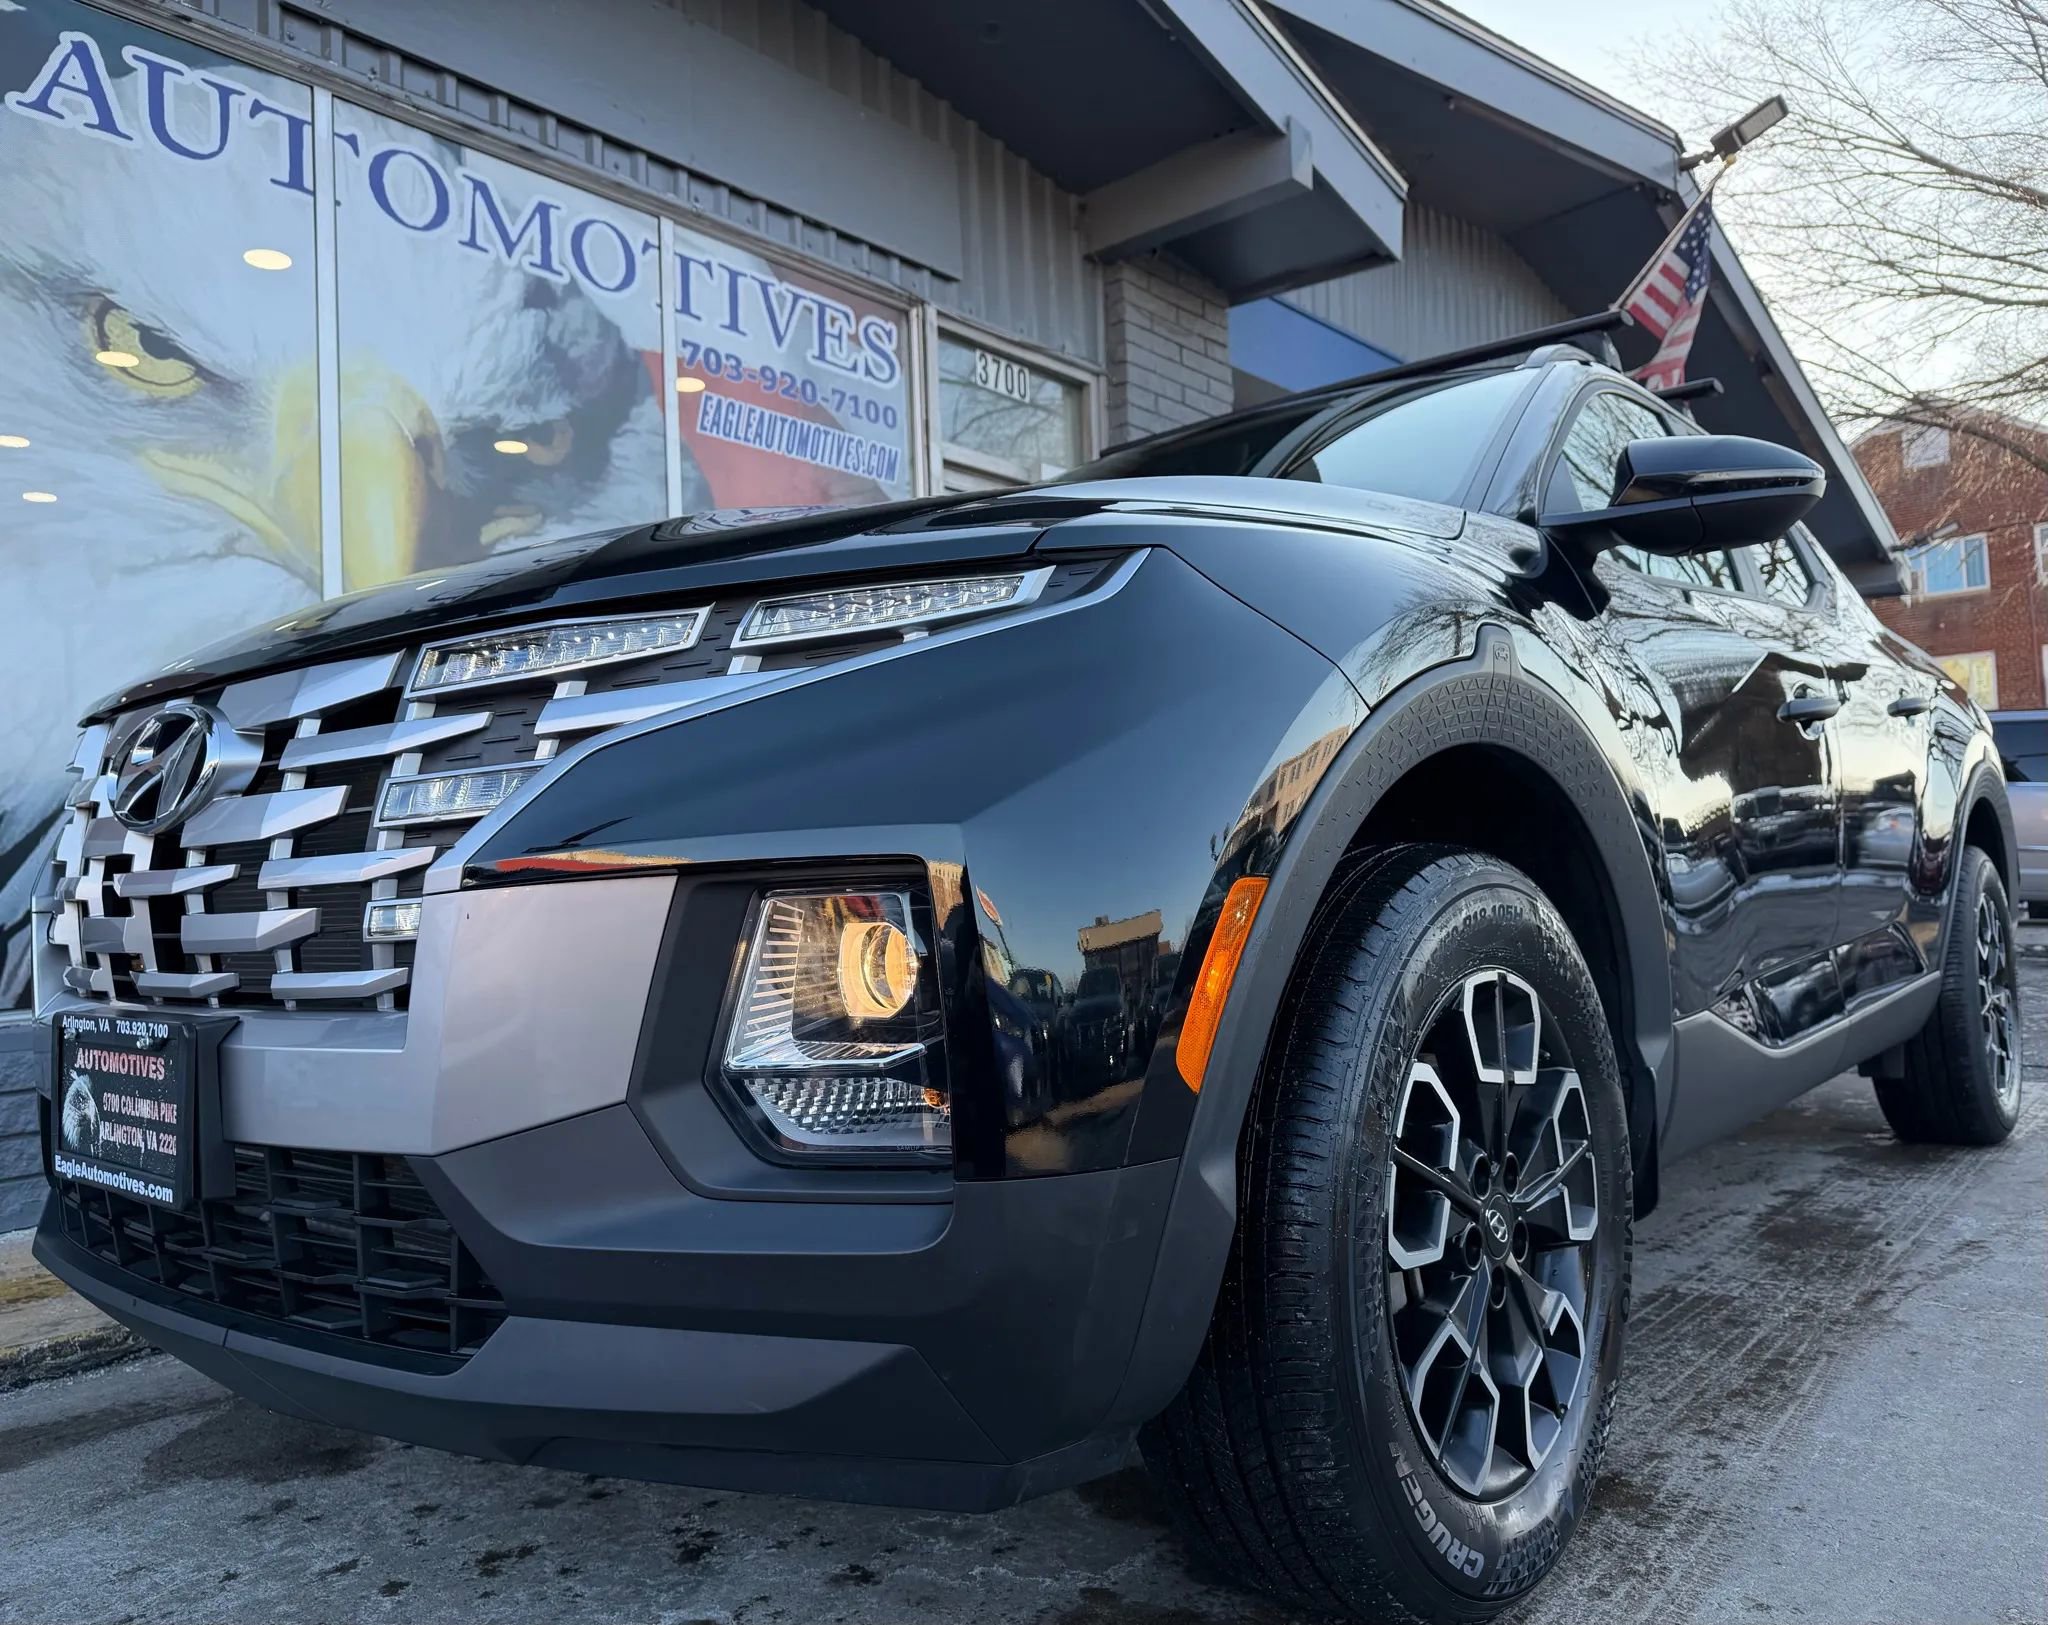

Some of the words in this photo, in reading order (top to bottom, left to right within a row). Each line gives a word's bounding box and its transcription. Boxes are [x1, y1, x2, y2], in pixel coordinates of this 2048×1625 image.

[8, 38, 898, 385] AUTOMOTIVES
[681, 338, 898, 430] 703-920-7100
[978, 353, 1028, 400] 3700
[699, 394, 899, 482] EAGLEAUTOMOTIVES.COM
[62, 1015, 98, 1034] Arlington,
[98, 1019, 111, 1033] VA
[75, 1049, 165, 1080] AUTOMOTIVES
[121, 1095, 159, 1122] COLUMBIA
[160, 1103, 177, 1125] PIKE
[146, 1130, 158, 1151] VA
[54, 1154, 174, 1203] EagleAutomotives.com
